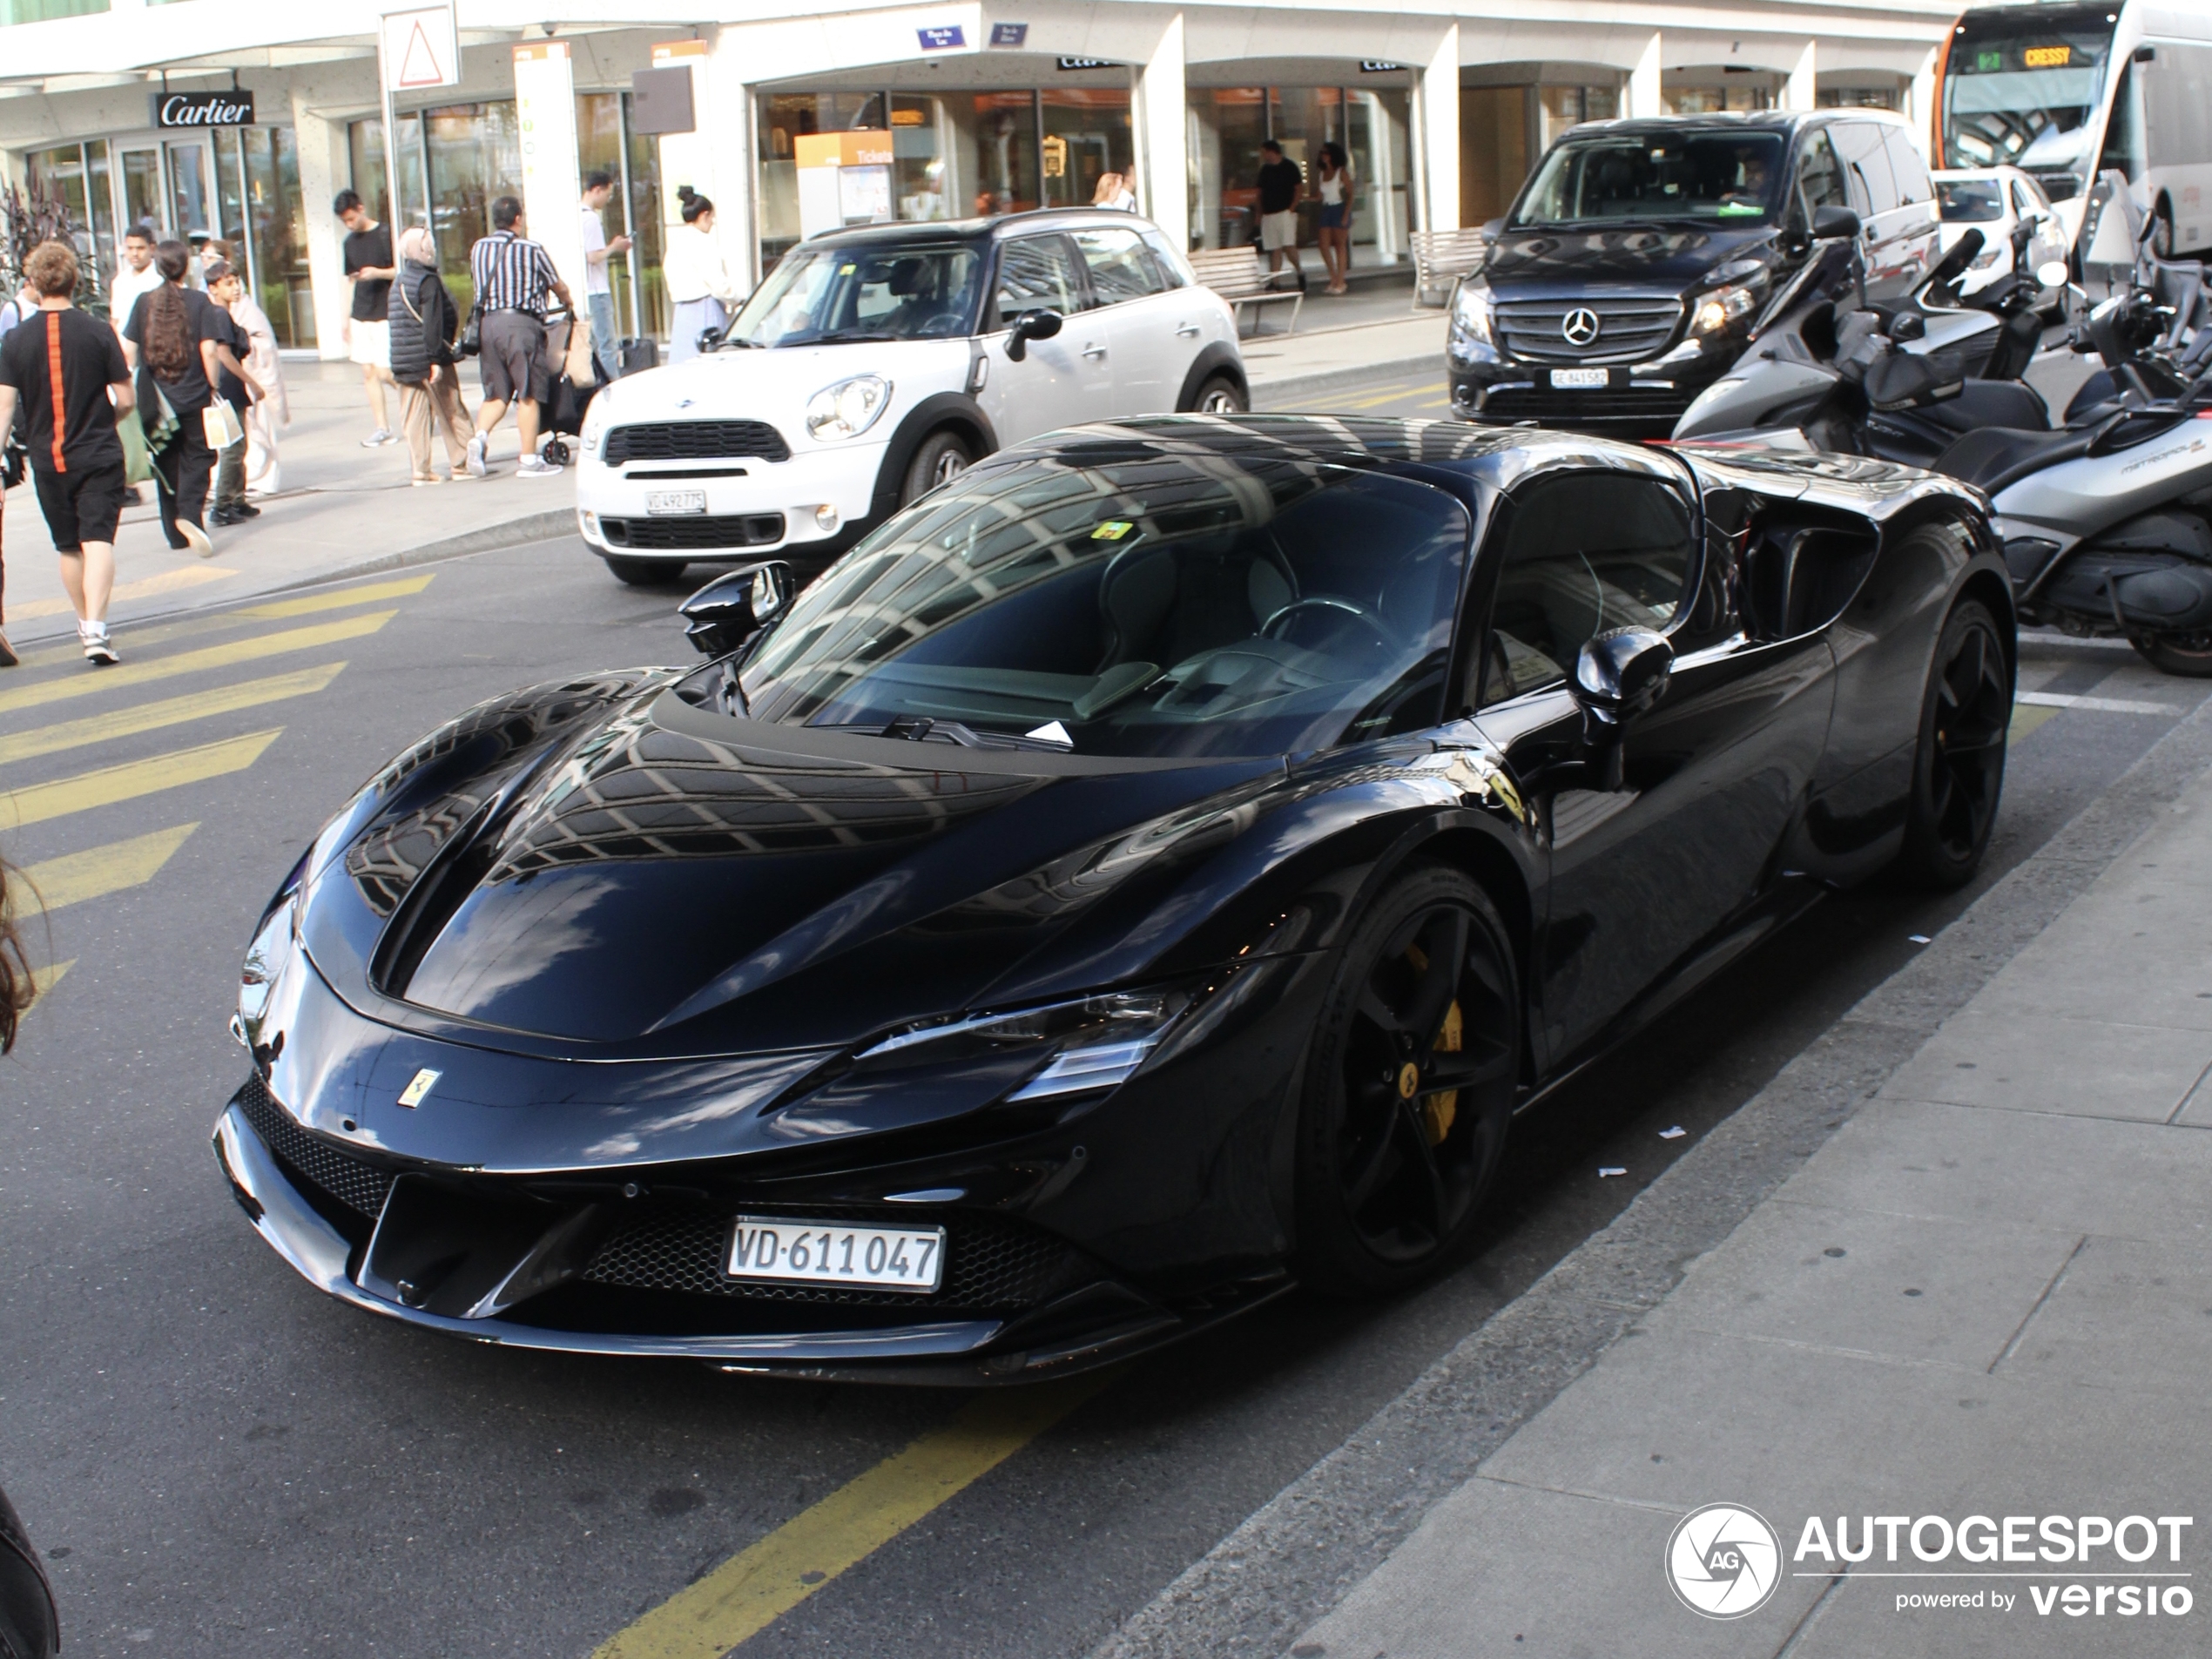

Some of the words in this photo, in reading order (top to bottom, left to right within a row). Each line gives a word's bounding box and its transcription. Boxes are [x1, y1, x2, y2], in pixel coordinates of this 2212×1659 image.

[2025, 47, 2070, 67] CRESSY
[161, 95, 251, 125] Cartier
[856, 149, 894, 165] Tickets
